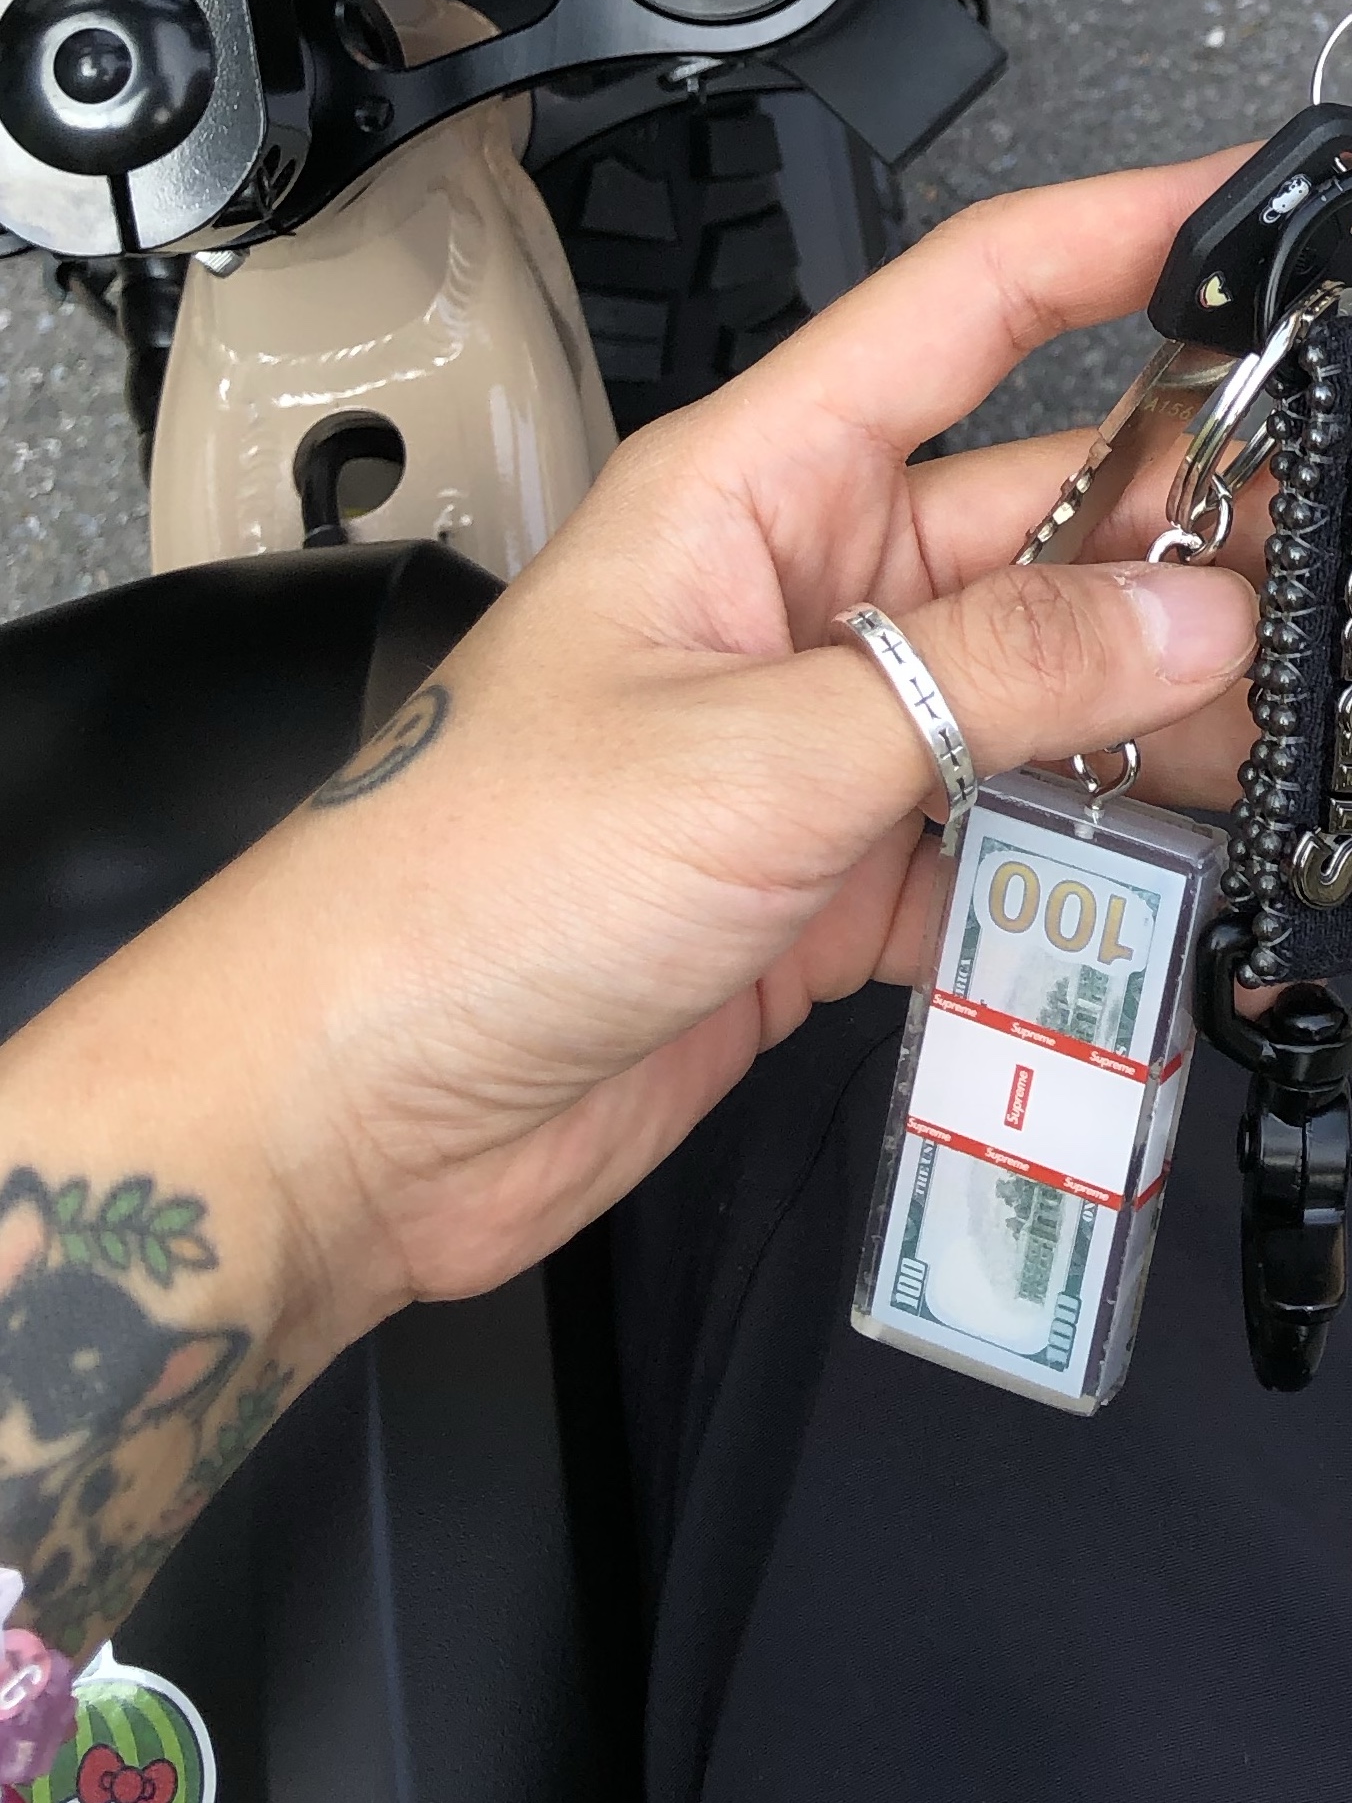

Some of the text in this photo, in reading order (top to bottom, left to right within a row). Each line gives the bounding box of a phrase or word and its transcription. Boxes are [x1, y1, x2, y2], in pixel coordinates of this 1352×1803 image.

[988, 860, 1135, 966] 100
[932, 993, 1136, 1076] Supreme Supreme Supreme
[1006, 1070, 1028, 1125] Supreme
[906, 1117, 1110, 1202] Supreme Supreme Supreme
[894, 1257, 926, 1309] 100
[1046, 1292, 1080, 1365] 100
